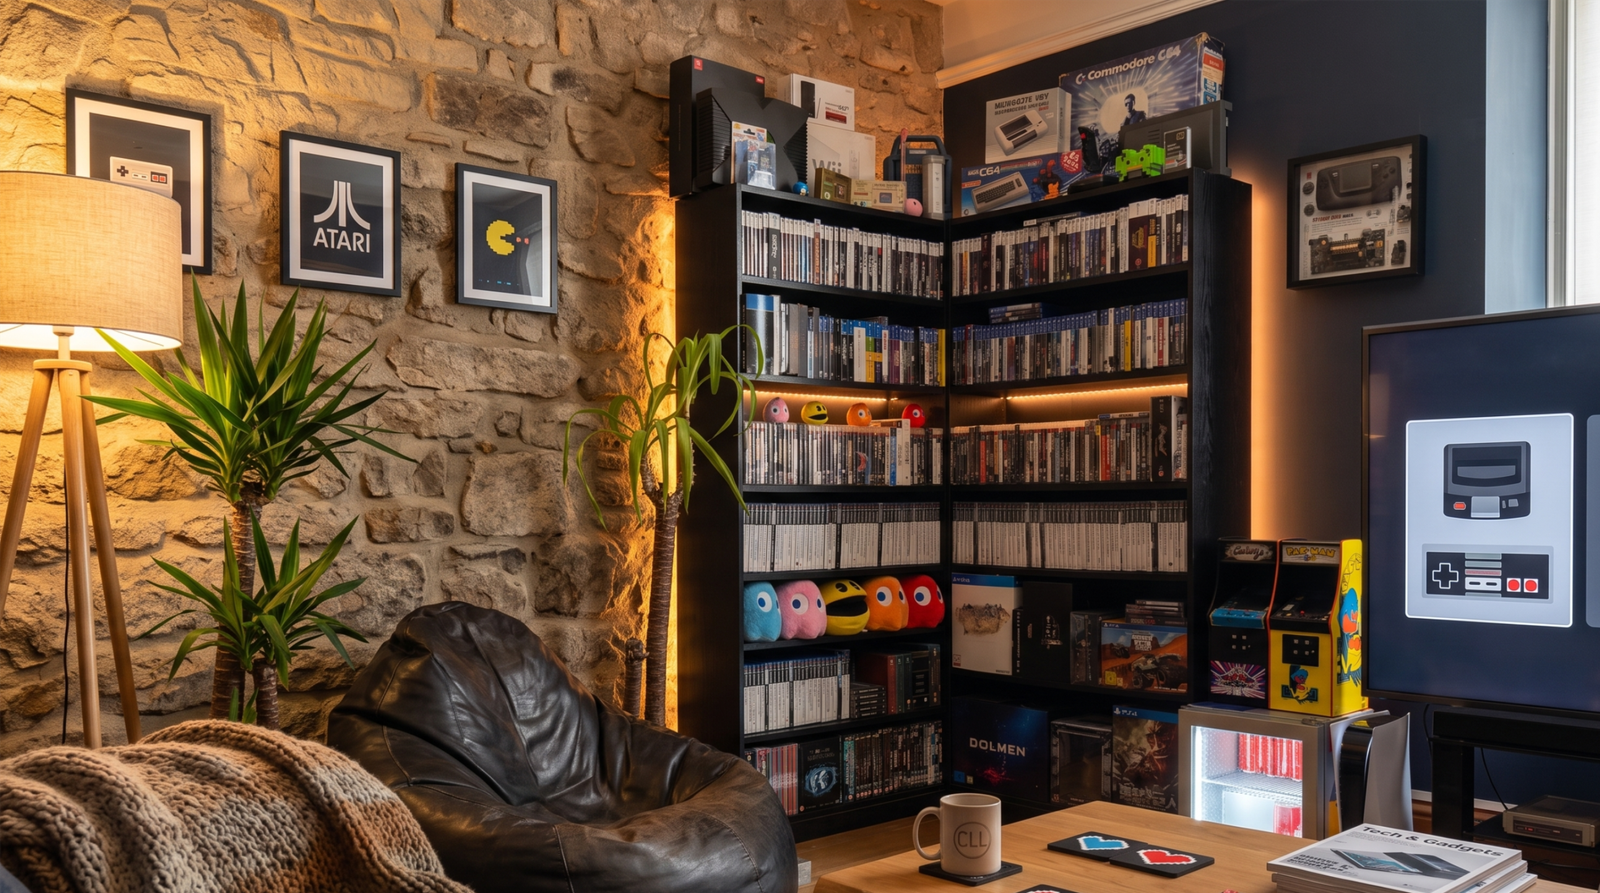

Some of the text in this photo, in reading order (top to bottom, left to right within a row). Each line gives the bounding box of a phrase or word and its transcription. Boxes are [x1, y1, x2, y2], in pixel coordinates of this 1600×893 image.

[1087, 54, 1155, 80] Commodore
[1157, 44, 1181, 61] C64
[313, 227, 370, 253] ATARI
[969, 737, 1026, 757] DOLMEN
[957, 830, 988, 848] CLL
[1362, 826, 1403, 838] Tech
[1423, 838, 1504, 857] Gadgets
